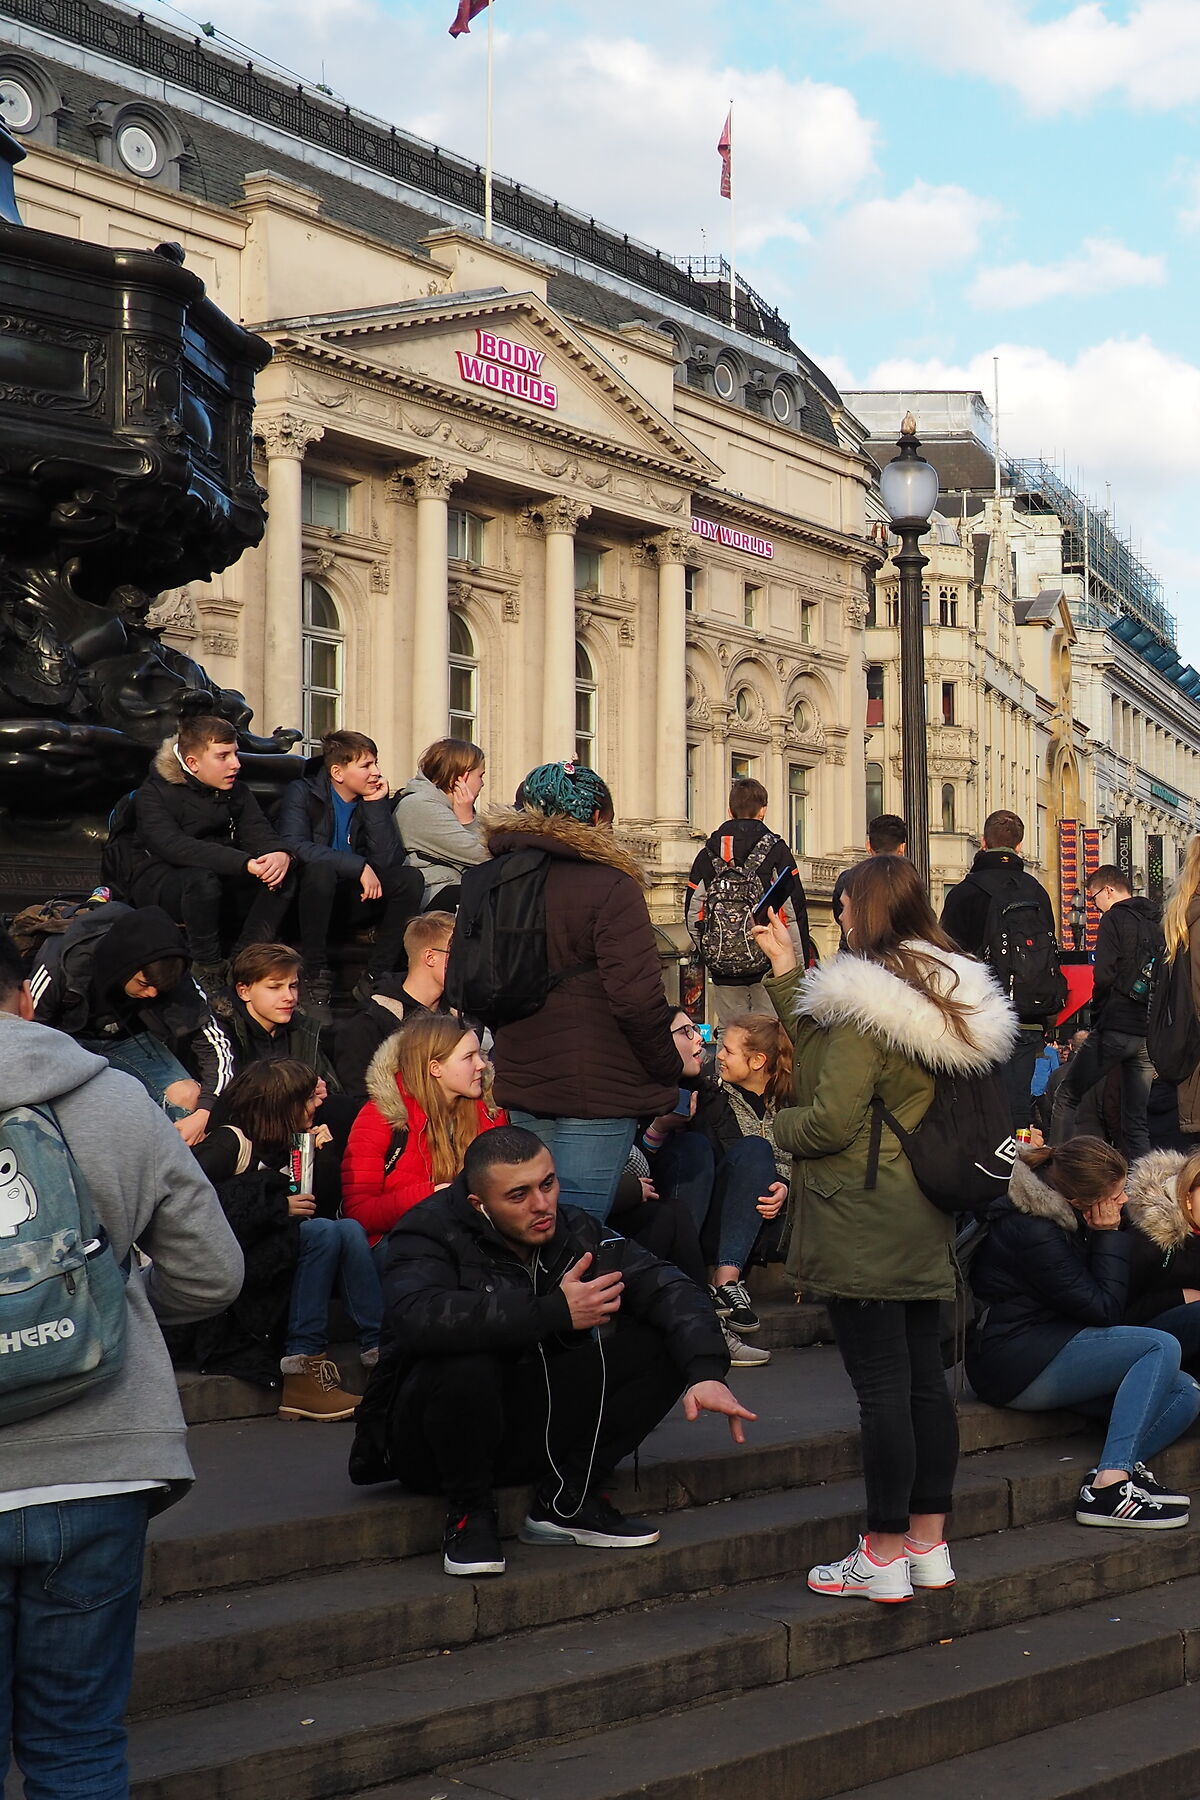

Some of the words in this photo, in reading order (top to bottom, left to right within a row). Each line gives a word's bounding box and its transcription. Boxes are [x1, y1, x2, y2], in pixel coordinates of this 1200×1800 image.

[478, 328, 546, 375] BODY
[458, 351, 558, 409] WORLDS
[691, 516, 719, 542] ODY
[720, 525, 774, 559] WORLDS
[0, 1317, 75, 1354] HERO
